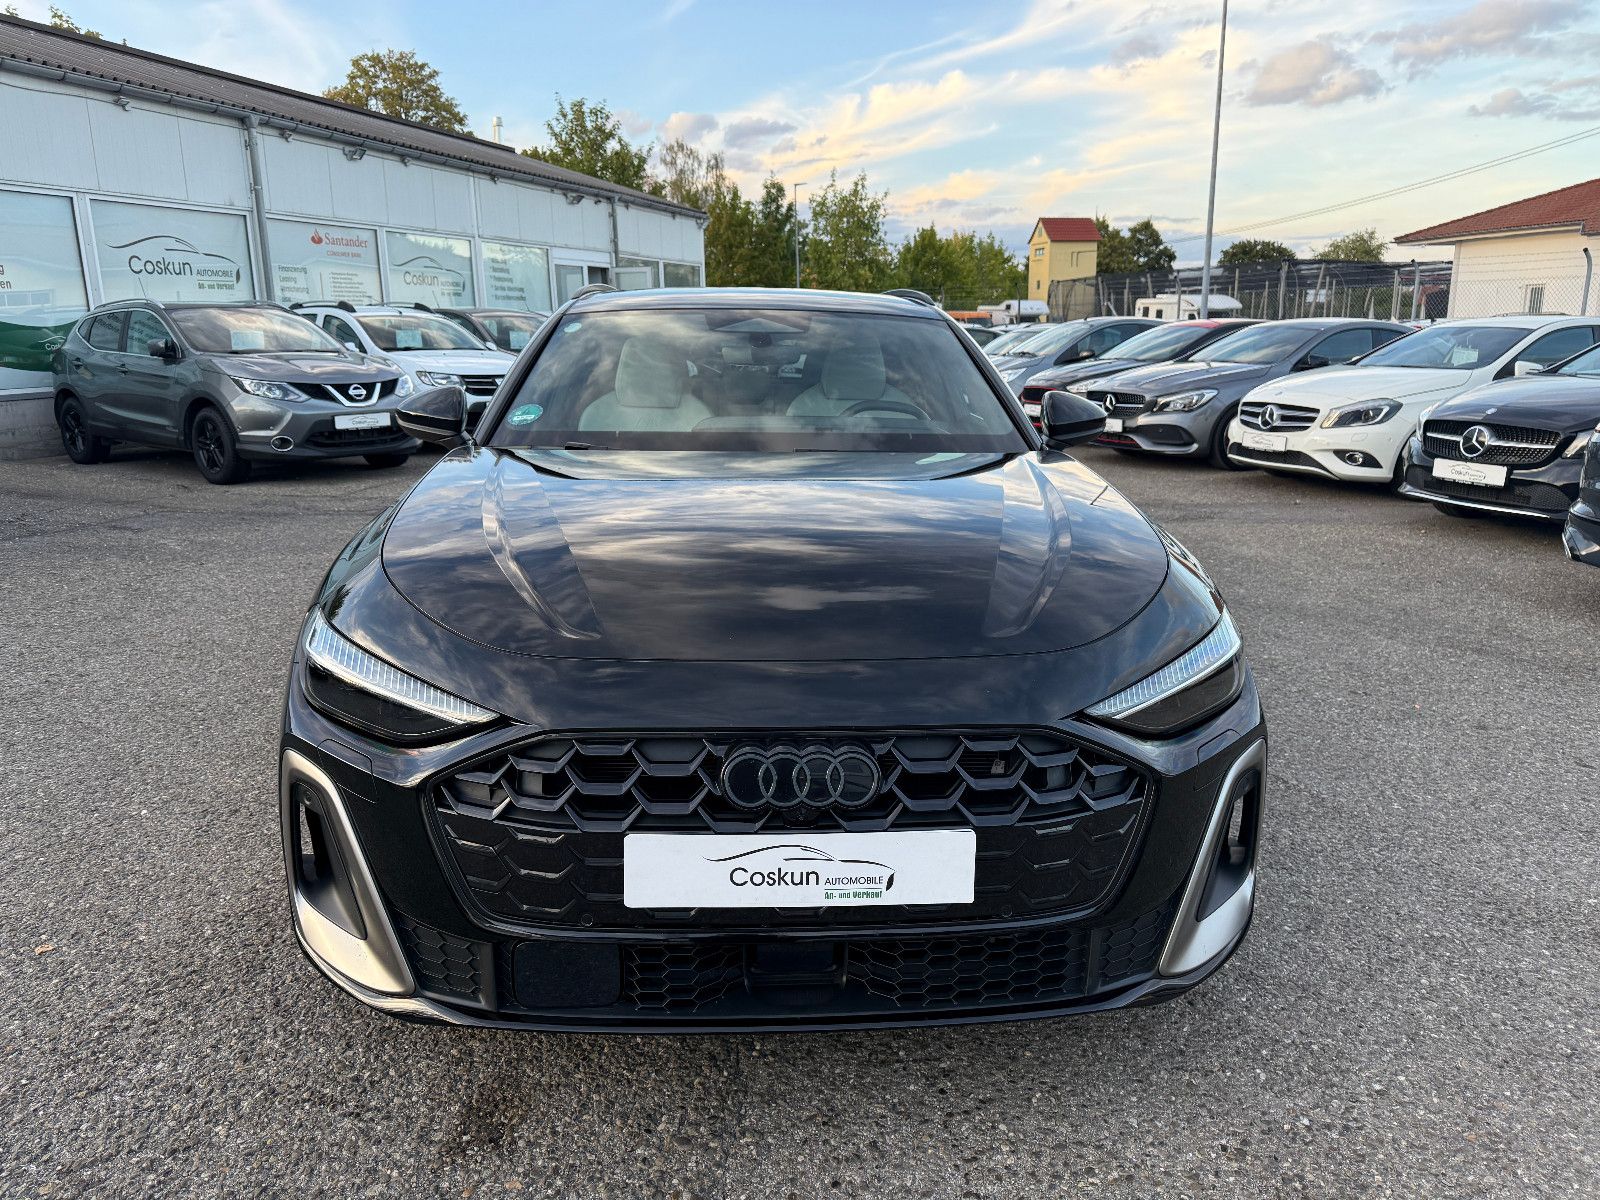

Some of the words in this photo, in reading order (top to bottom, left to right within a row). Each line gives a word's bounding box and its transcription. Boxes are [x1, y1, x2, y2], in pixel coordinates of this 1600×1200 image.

[324, 232, 368, 248] Santander
[128, 254, 193, 276] Coskun
[196, 268, 234, 278] AUTOMOBILE
[403, 271, 439, 286] Coskun
[729, 866, 820, 887] Coskun
[824, 876, 884, 886] AUTOMOBILE
[824, 891, 837, 900] An-
[838, 891, 851, 899] und
[852, 890, 883, 899] Verkauf
